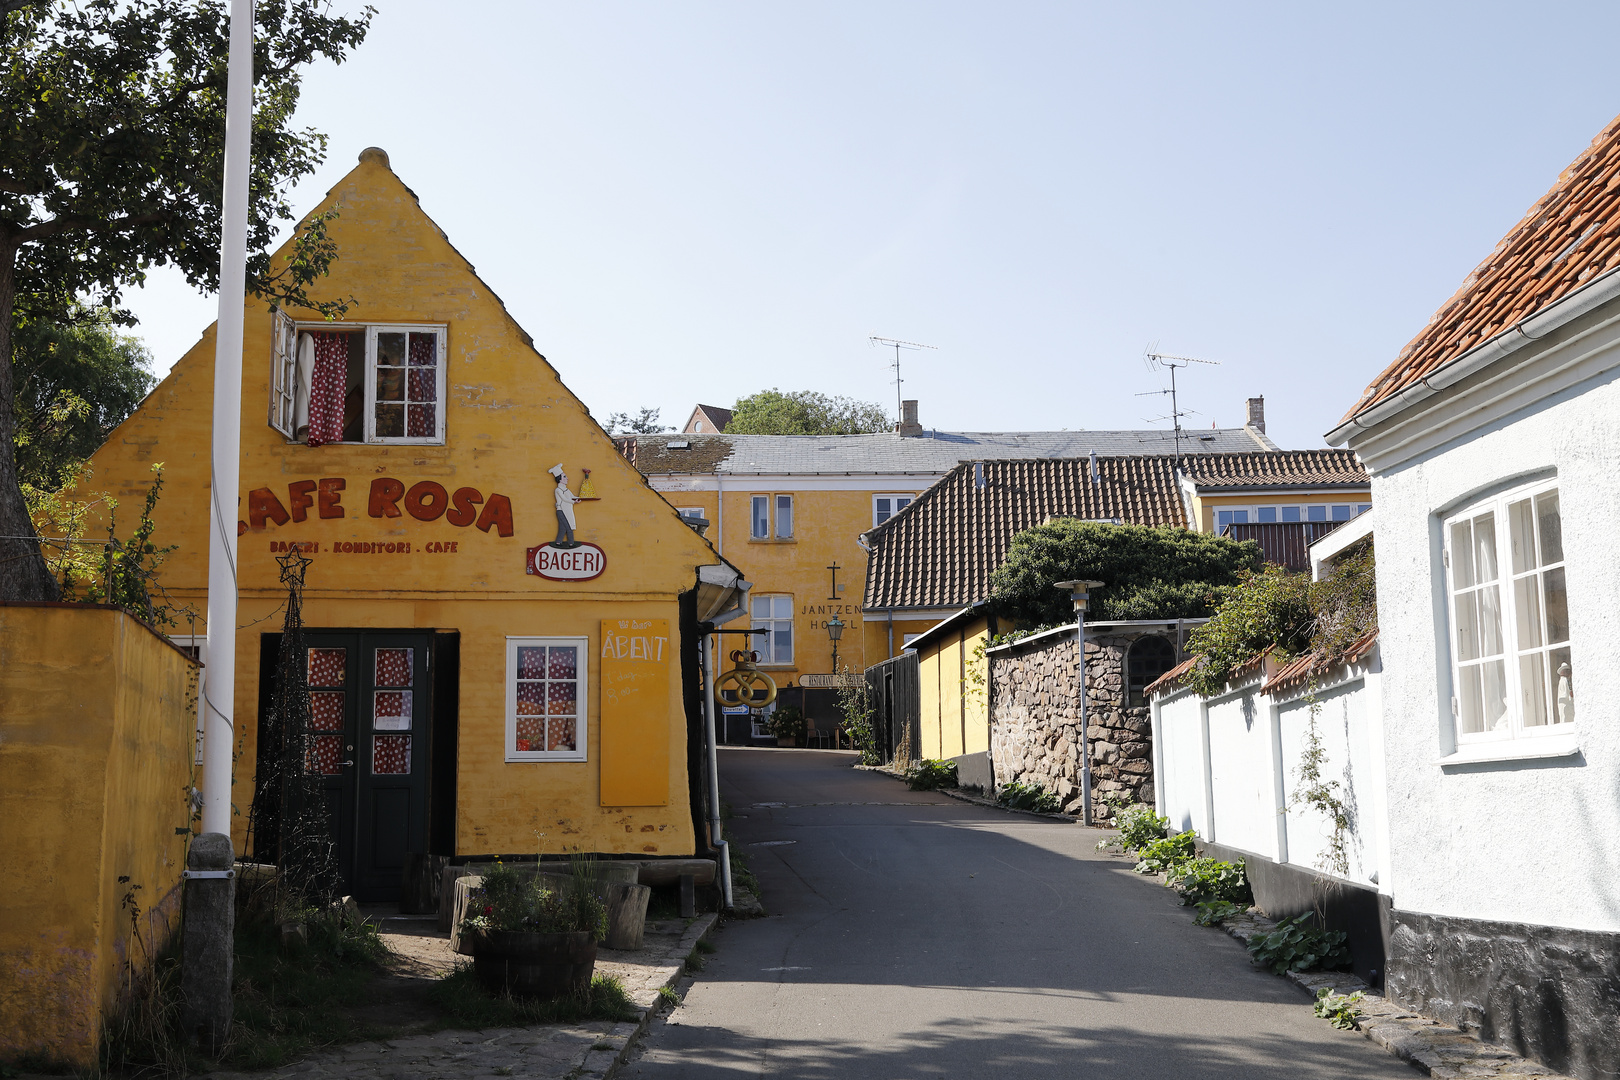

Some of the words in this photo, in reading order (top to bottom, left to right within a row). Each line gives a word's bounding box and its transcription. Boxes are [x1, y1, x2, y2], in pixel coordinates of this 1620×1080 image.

[238, 477, 347, 537] AFE
[367, 477, 515, 538] ROSA
[425, 541, 459, 554] CAFE
[538, 551, 600, 571] BAGERI
[801, 604, 862, 615] JANTZEN
[810, 619, 858, 630] HOEL
[601, 630, 668, 661] ÅBENT
